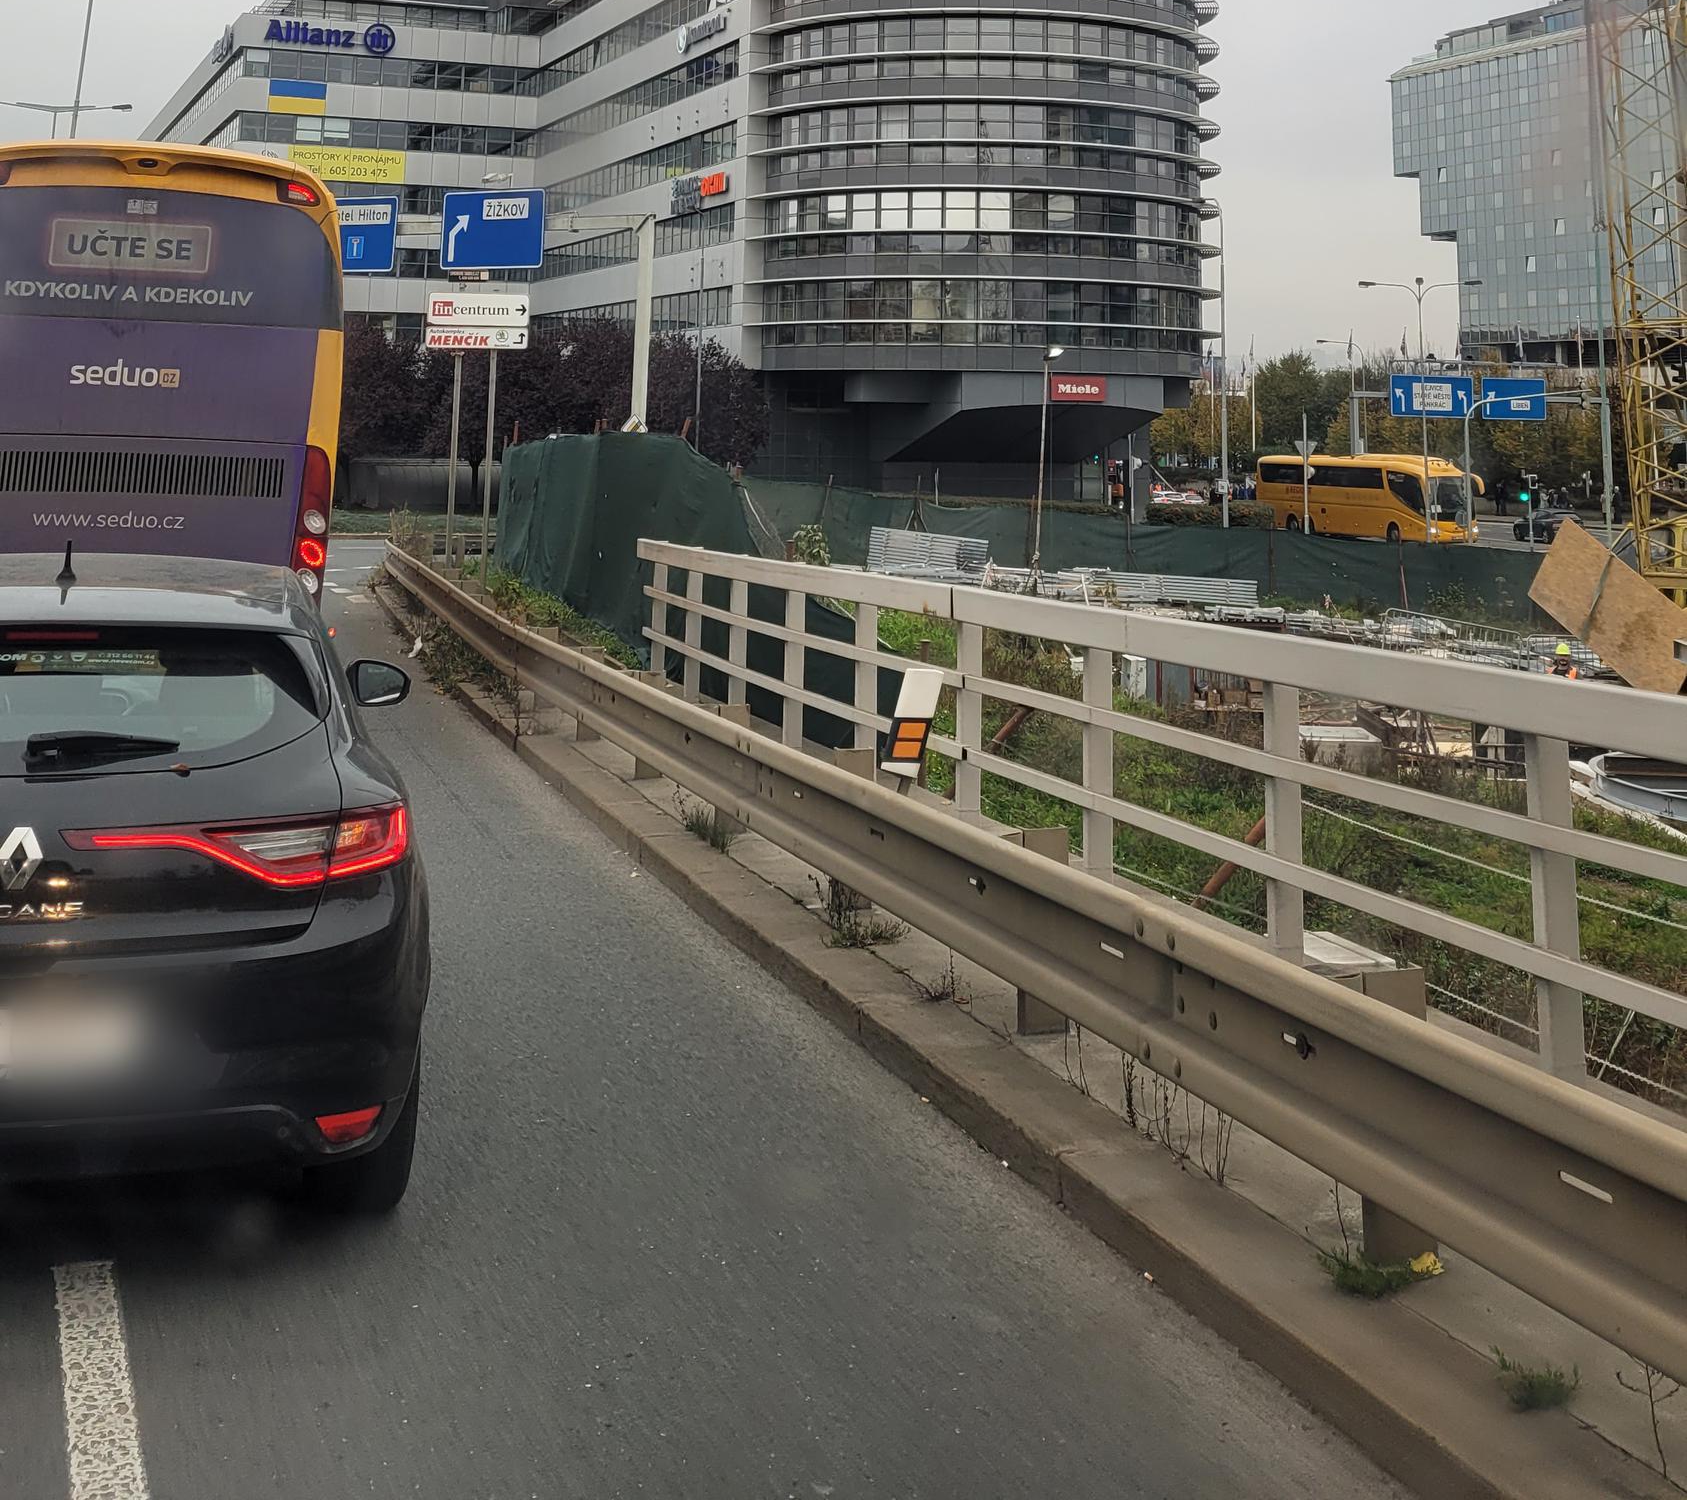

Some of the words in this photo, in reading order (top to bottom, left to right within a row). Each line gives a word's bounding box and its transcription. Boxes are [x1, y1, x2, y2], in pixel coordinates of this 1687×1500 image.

[264, 19, 356, 48] Allianz
[292, 148, 342, 162] PROSTORY
[343, 154, 351, 162] K
[352, 154, 402, 166] PRONÁJMU
[329, 165, 347, 176] 605
[350, 166, 368, 177] 203
[370, 167, 388, 178] 475
[358, 209, 389, 222] Hilton
[486, 201, 526, 218] ŽIŽKOV
[67, 229, 147, 259] UČTE
[155, 238, 192, 261] SE
[4, 280, 117, 301] KDYKOLIV
[121, 286, 139, 302] A
[145, 287, 253, 307] KDEKOLIV
[433, 301, 510, 316] fincentrum
[428, 332, 491, 346] MENČÍK
[69, 358, 159, 387] seduo
[1057, 384, 1100, 395] Miele
[1422, 384, 1444, 392] EJVICE
[32, 510, 185, 530] www.seduo.cz
[0, 653, 27, 662] OM
